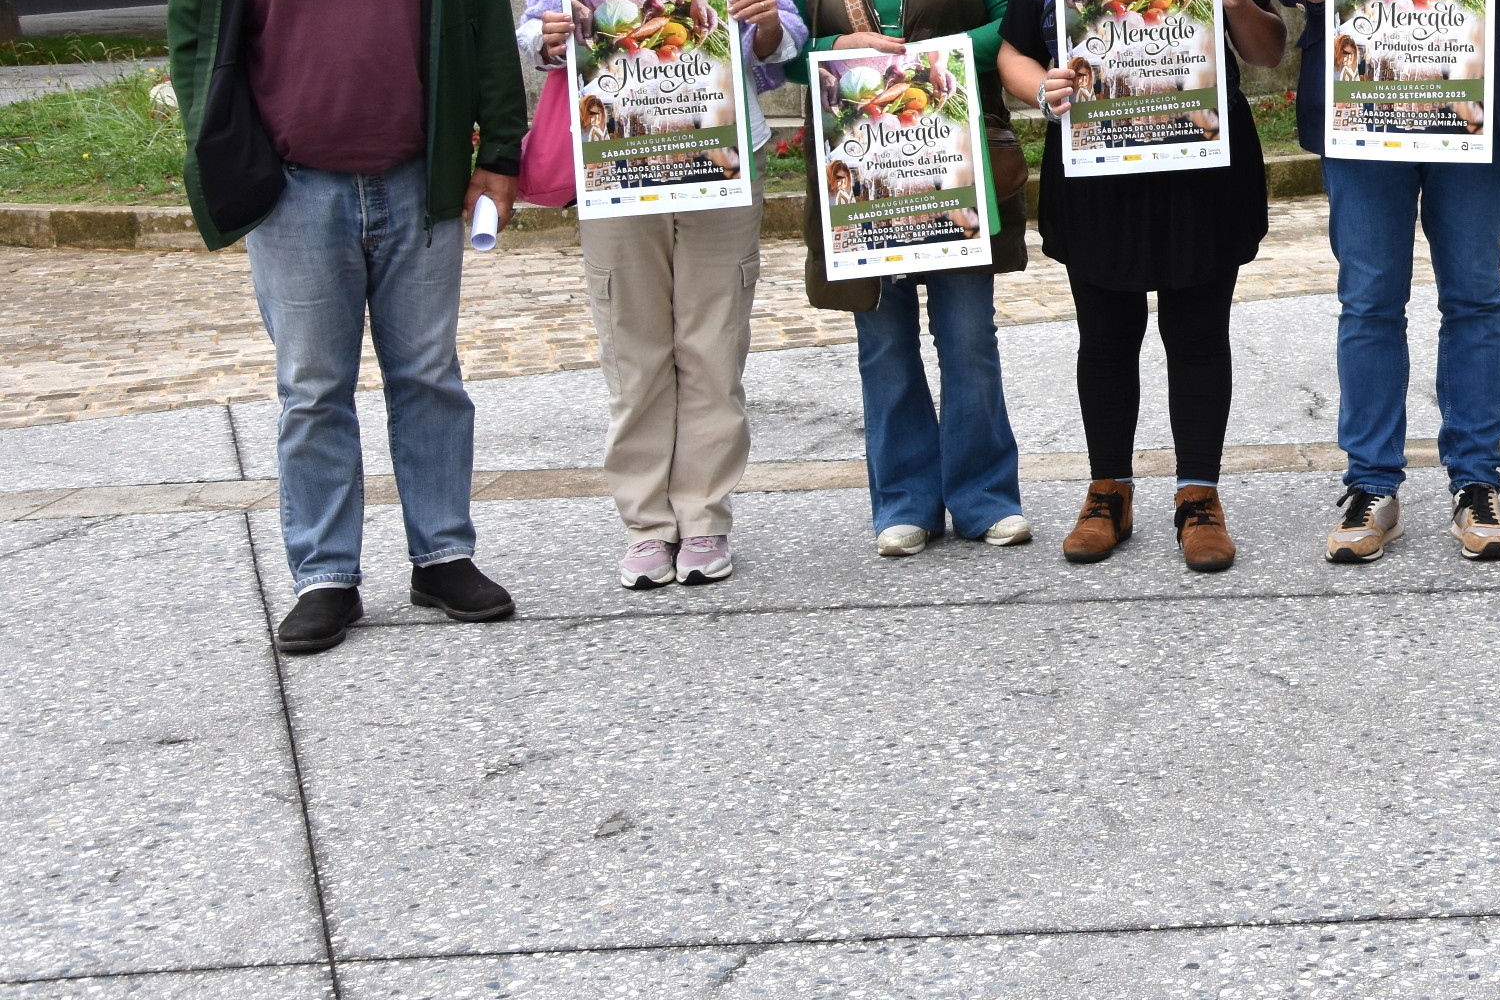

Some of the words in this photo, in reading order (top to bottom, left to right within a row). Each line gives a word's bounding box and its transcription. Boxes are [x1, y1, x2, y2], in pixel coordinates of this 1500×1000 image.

[1353, 1, 1465, 41] Mercado
[1086, 15, 1195, 60] Mercado
[1374, 41, 1423, 51] Produtos
[1428, 42, 1440, 52] da
[1444, 42, 1475, 53] Horta
[1108, 57, 1157, 69] Produtos
[1161, 55, 1173, 65] da
[1176, 54, 1206, 64] Horta
[1404, 53, 1457, 64] Artesanía
[598, 52, 711, 98] Mercado
[1138, 66, 1190, 78] Artesanía
[621, 95, 673, 107] Produtos
[676, 93, 690, 103] da
[693, 91, 724, 102] Horta
[1112, 95, 1177, 108] INAUGURACIÓN
[1350, 91, 1385, 100] SÁBADO
[1399, 91, 1444, 99] SETEMBRO
[653, 103, 708, 116] Artesanía
[1088, 108, 1122, 119] SÁBADO
[1124, 107, 1134, 115] 20
[1136, 102, 1179, 113] SETEMBRO
[1181, 100, 1201, 109] 2025
[1359, 109, 1395, 118] SÁBADOS
[1097, 125, 1133, 135] SÁBADOS
[1174, 121, 1194, 129] 13.30
[1413, 118, 1468, 127] BERTAMIRÁNS
[627, 133, 695, 147] INAUGURACIÓN
[843, 116, 951, 162] Mercado
[1086, 135, 1112, 143] PRAZA
[1152, 127, 1205, 138] BERTAMIRÁNS
[601, 147, 638, 159] SÁBADO
[639, 146, 650, 154] 20
[652, 140, 697, 152] SETEMBRO
[698, 138, 720, 147] 2025
[611, 165, 650, 175] SÁBADOS
[692, 160, 713, 168] 13.30
[866, 158, 914, 171] Produtos
[918, 155, 931, 165] da
[933, 153, 963, 164] Horta
[600, 175, 627, 183] PRAZA
[628, 173, 639, 181] DA
[669, 166, 724, 177] BERTAMIRÁNS
[896, 165, 948, 178] Artesanía
[872, 195, 936, 209] INAUGURACIÓN
[848, 209, 882, 222] SÁBADO
[884, 207, 894, 216] 20
[895, 201, 939, 214] SETEMBRO
[939, 199, 960, 208] 2025
[847, 236, 873, 245] PRAZA
[912, 226, 965, 238] BERTAMIRÁNS
[857, 226, 894, 237] SÁBADOS
[895, 225, 904, 233] DE
[934, 220, 954, 228] 13.30
